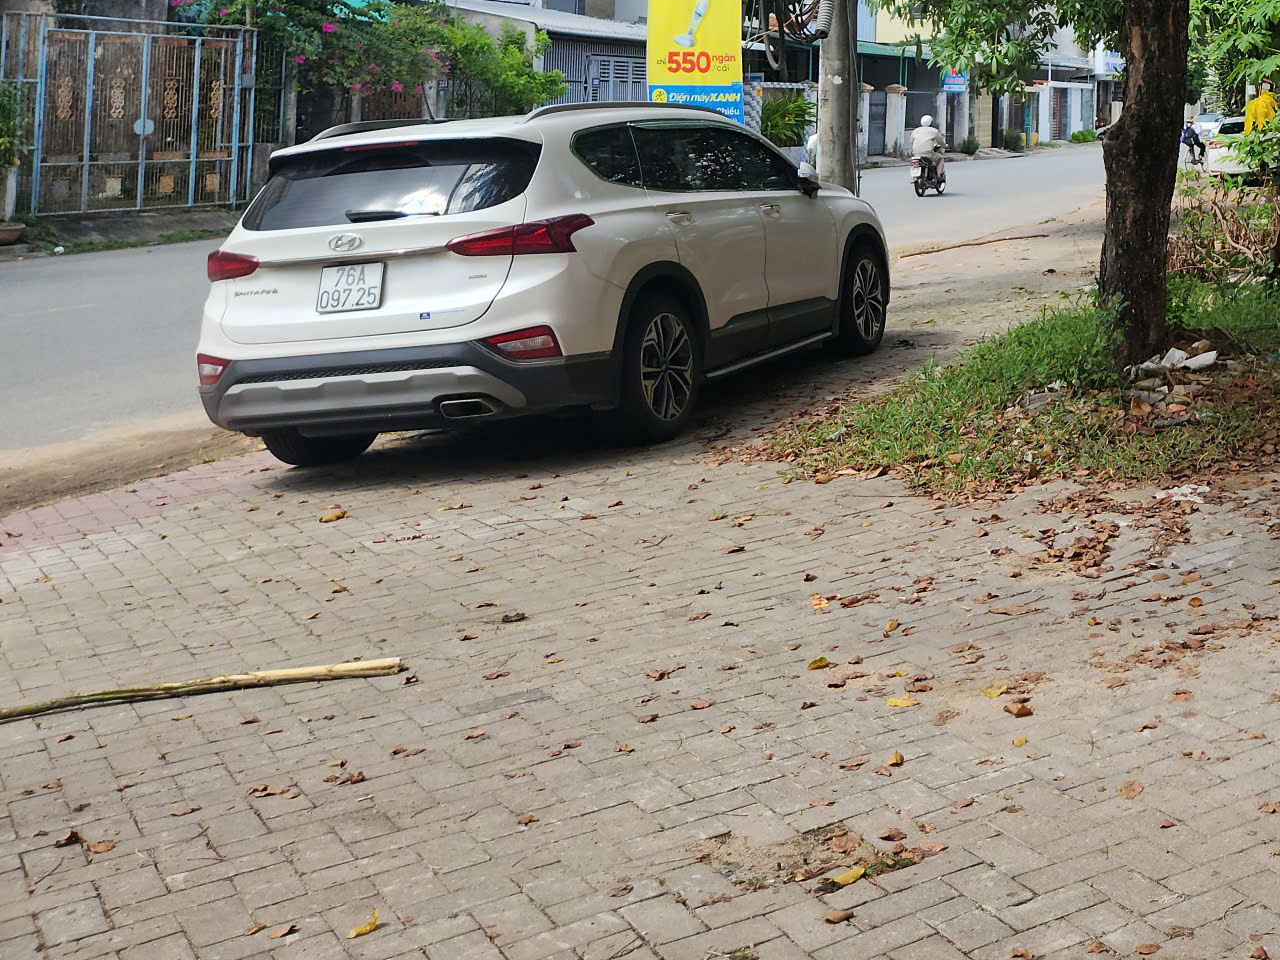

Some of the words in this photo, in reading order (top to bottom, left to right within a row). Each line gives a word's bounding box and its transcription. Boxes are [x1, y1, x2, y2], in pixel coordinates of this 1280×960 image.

[667, 51, 711, 74] 550
[668, 92, 690, 104] Điện
[335, 266, 366, 288] 76A
[318, 288, 377, 310] 097.25
